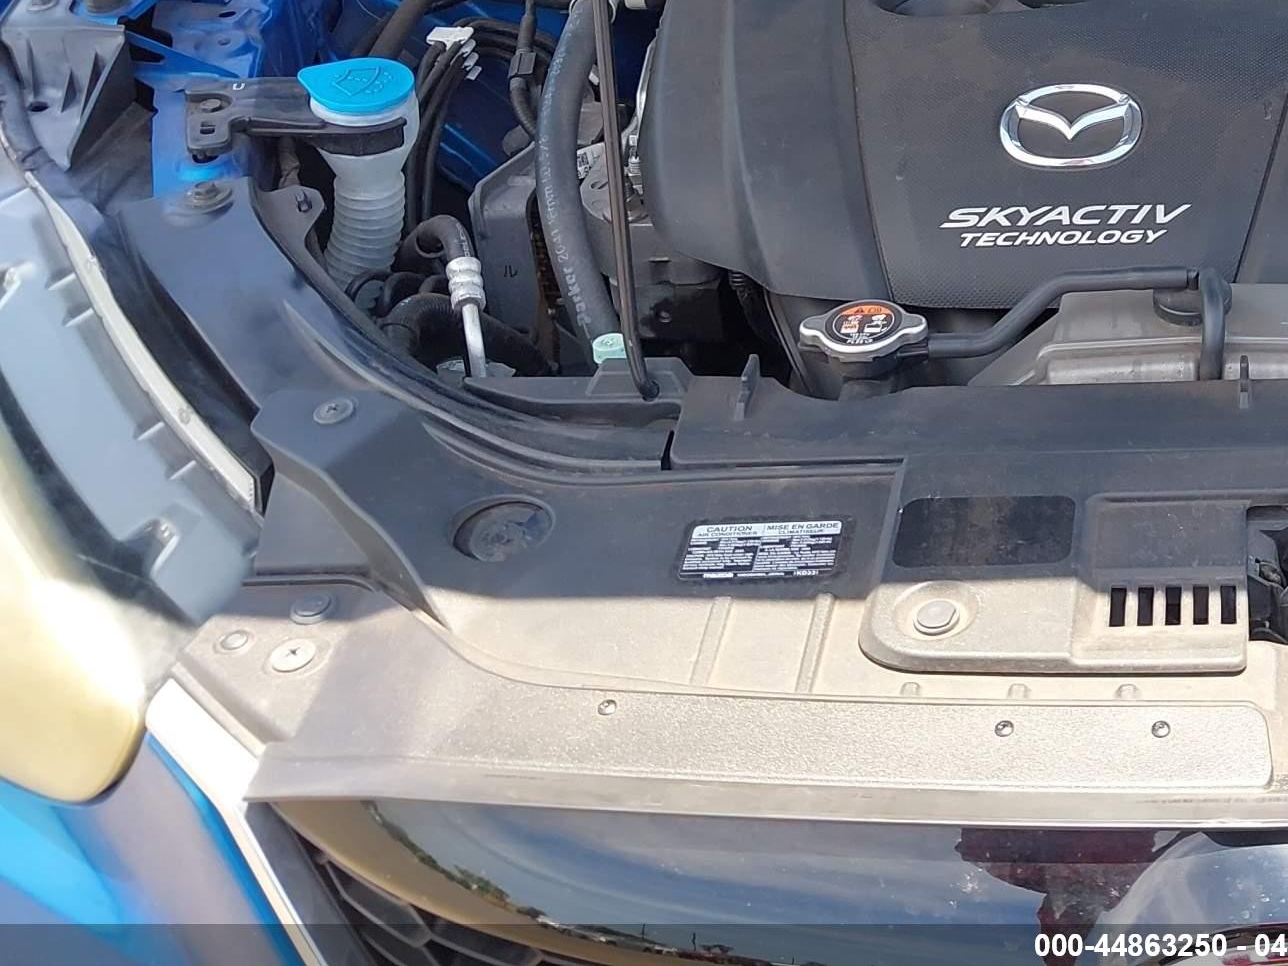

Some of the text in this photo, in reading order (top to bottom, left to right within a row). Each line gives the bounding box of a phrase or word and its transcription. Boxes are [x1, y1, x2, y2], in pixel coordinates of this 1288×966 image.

[939, 204, 1192, 228] SKYACTIV
[960, 229, 1168, 247] TECHNOLOGY
[706, 525, 752, 533] CAUTION
